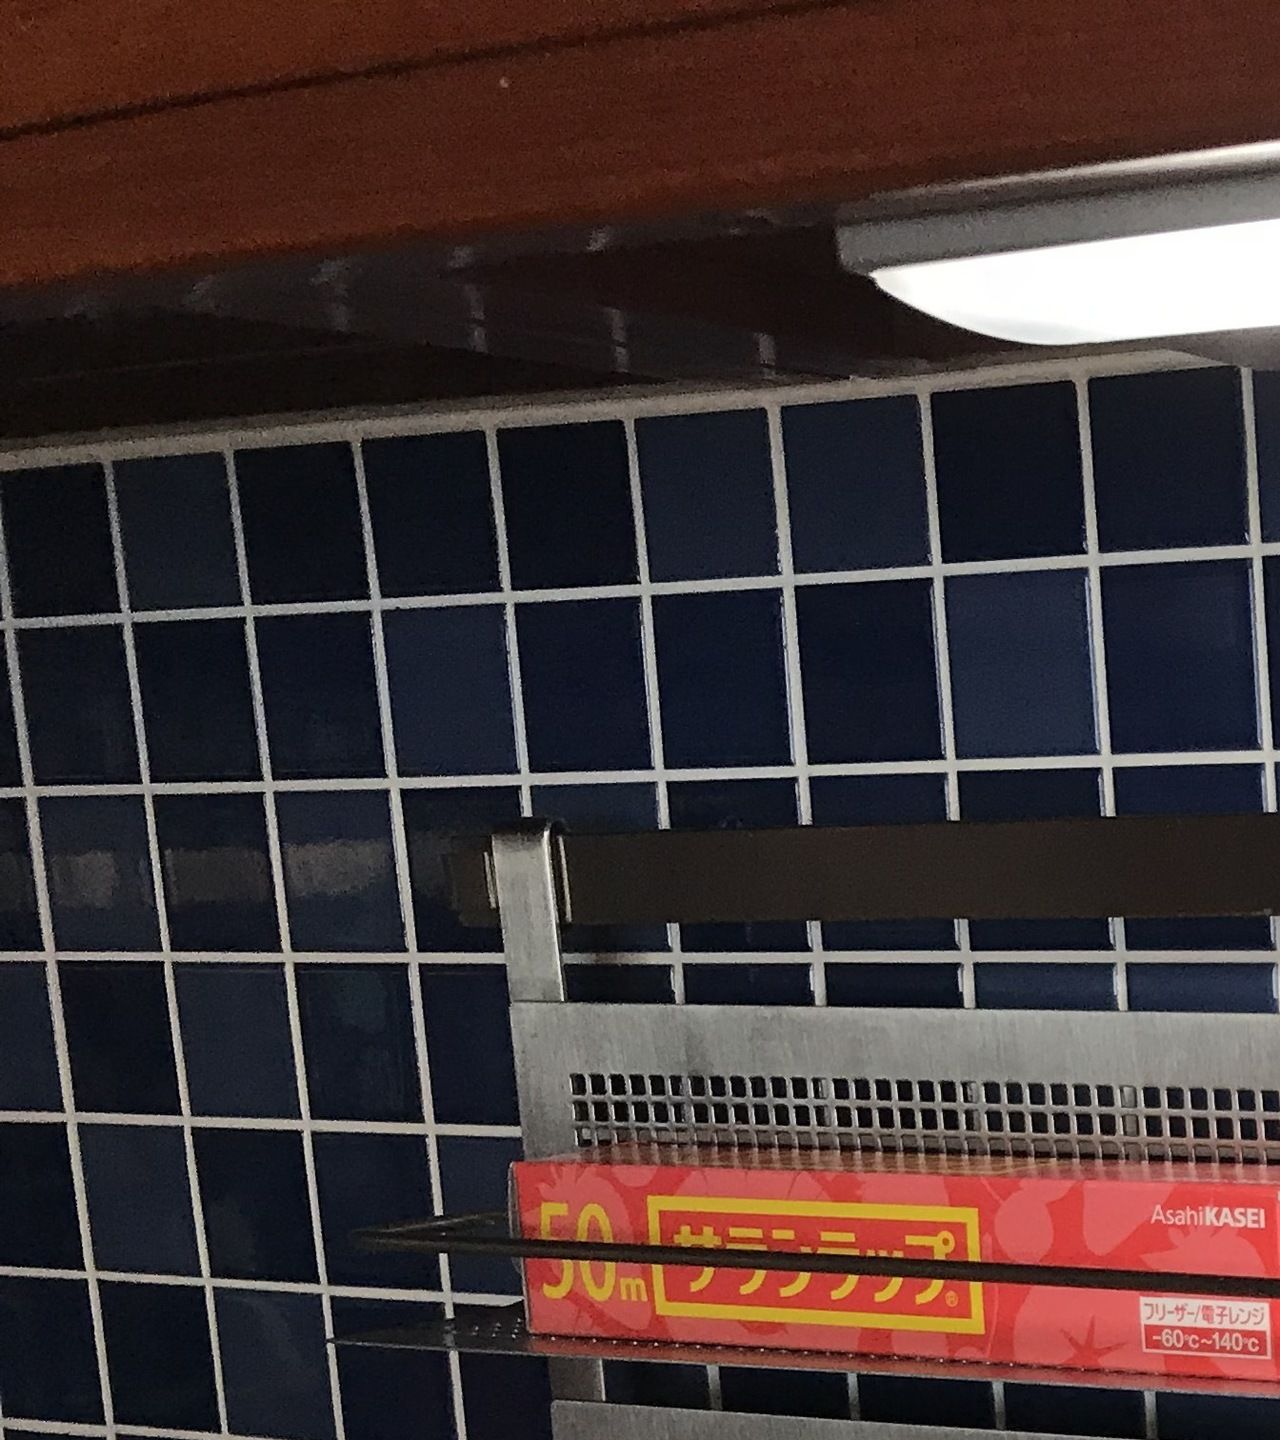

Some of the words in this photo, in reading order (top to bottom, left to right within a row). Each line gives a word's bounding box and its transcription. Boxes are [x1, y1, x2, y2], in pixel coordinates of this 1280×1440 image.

[540, 1201, 648, 1302] 50m
[1150, 1204, 1266, 1229] AsahiKASEI
[673, 1225, 957, 1305] サランラップ
